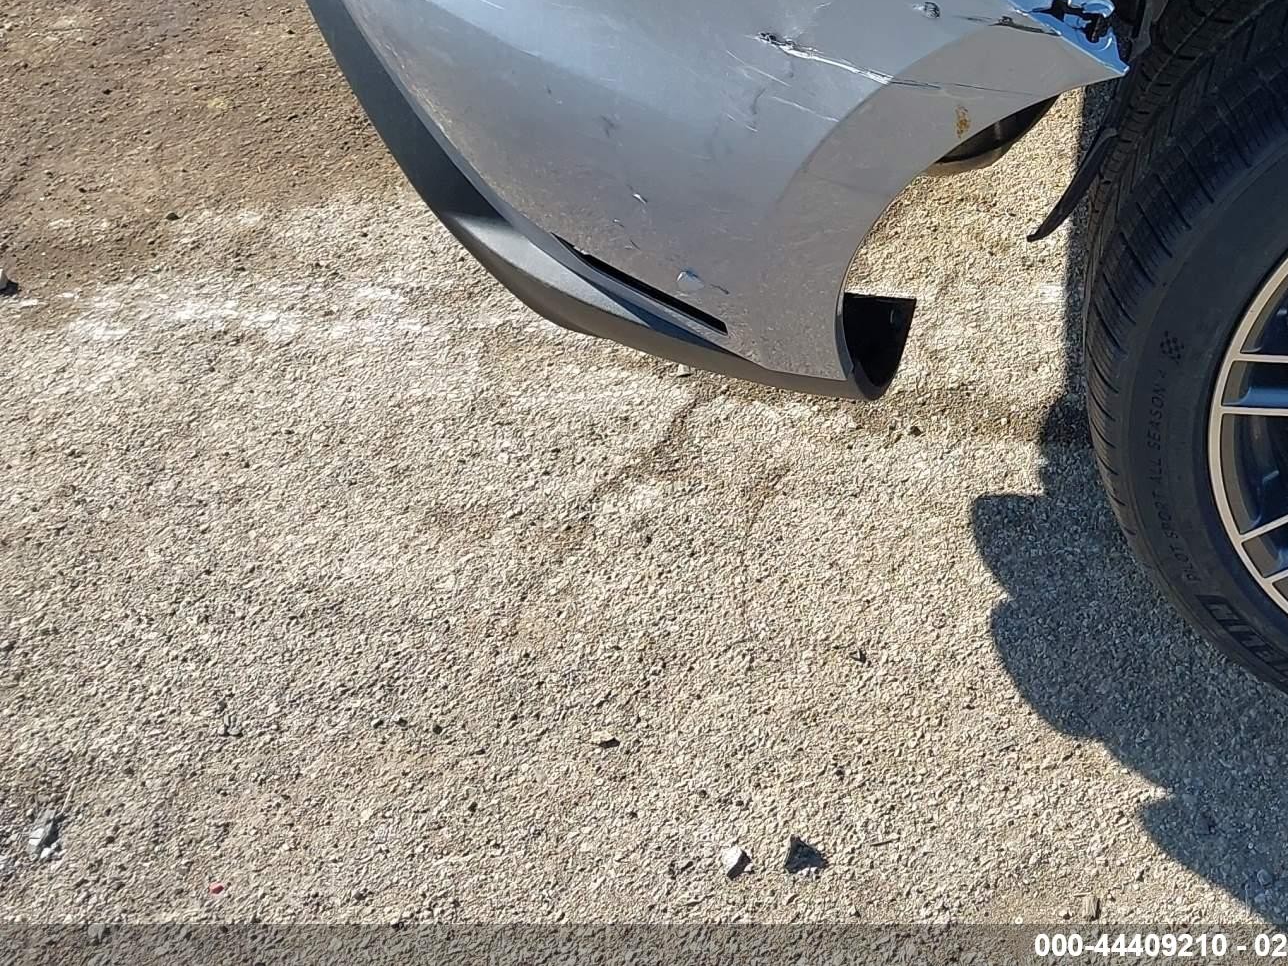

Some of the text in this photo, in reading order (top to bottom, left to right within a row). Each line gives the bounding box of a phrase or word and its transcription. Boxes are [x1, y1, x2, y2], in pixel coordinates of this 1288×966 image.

[1146, 381, 1166, 451] SEASON
[1148, 456, 1163, 484] ALL
[1152, 490, 1179, 539] SPORT
[1170, 543, 1202, 582] PILOT
